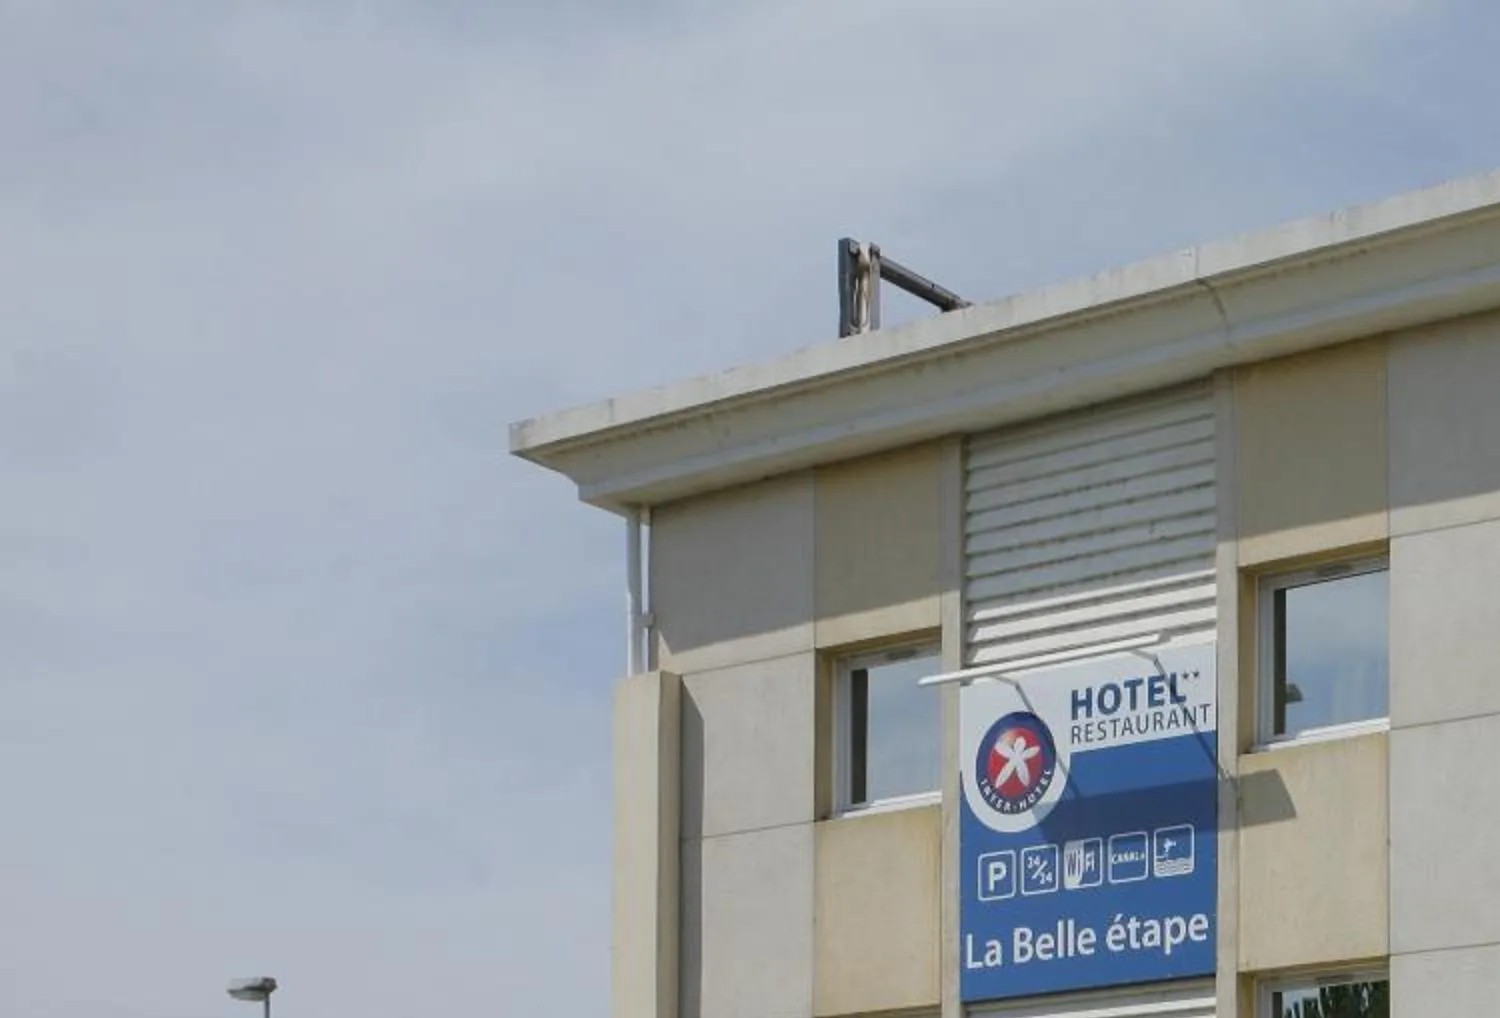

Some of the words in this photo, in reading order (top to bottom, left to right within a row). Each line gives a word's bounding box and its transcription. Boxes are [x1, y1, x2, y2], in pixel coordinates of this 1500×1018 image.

[1071, 672, 1187, 721] HOTEL
[1071, 703, 1211, 745] RESTAURANT
[987, 861, 1007, 893] P
[966, 934, 1002, 969] La
[1013, 919, 1097, 964] Belle
[1106, 912, 1210, 956] étape
